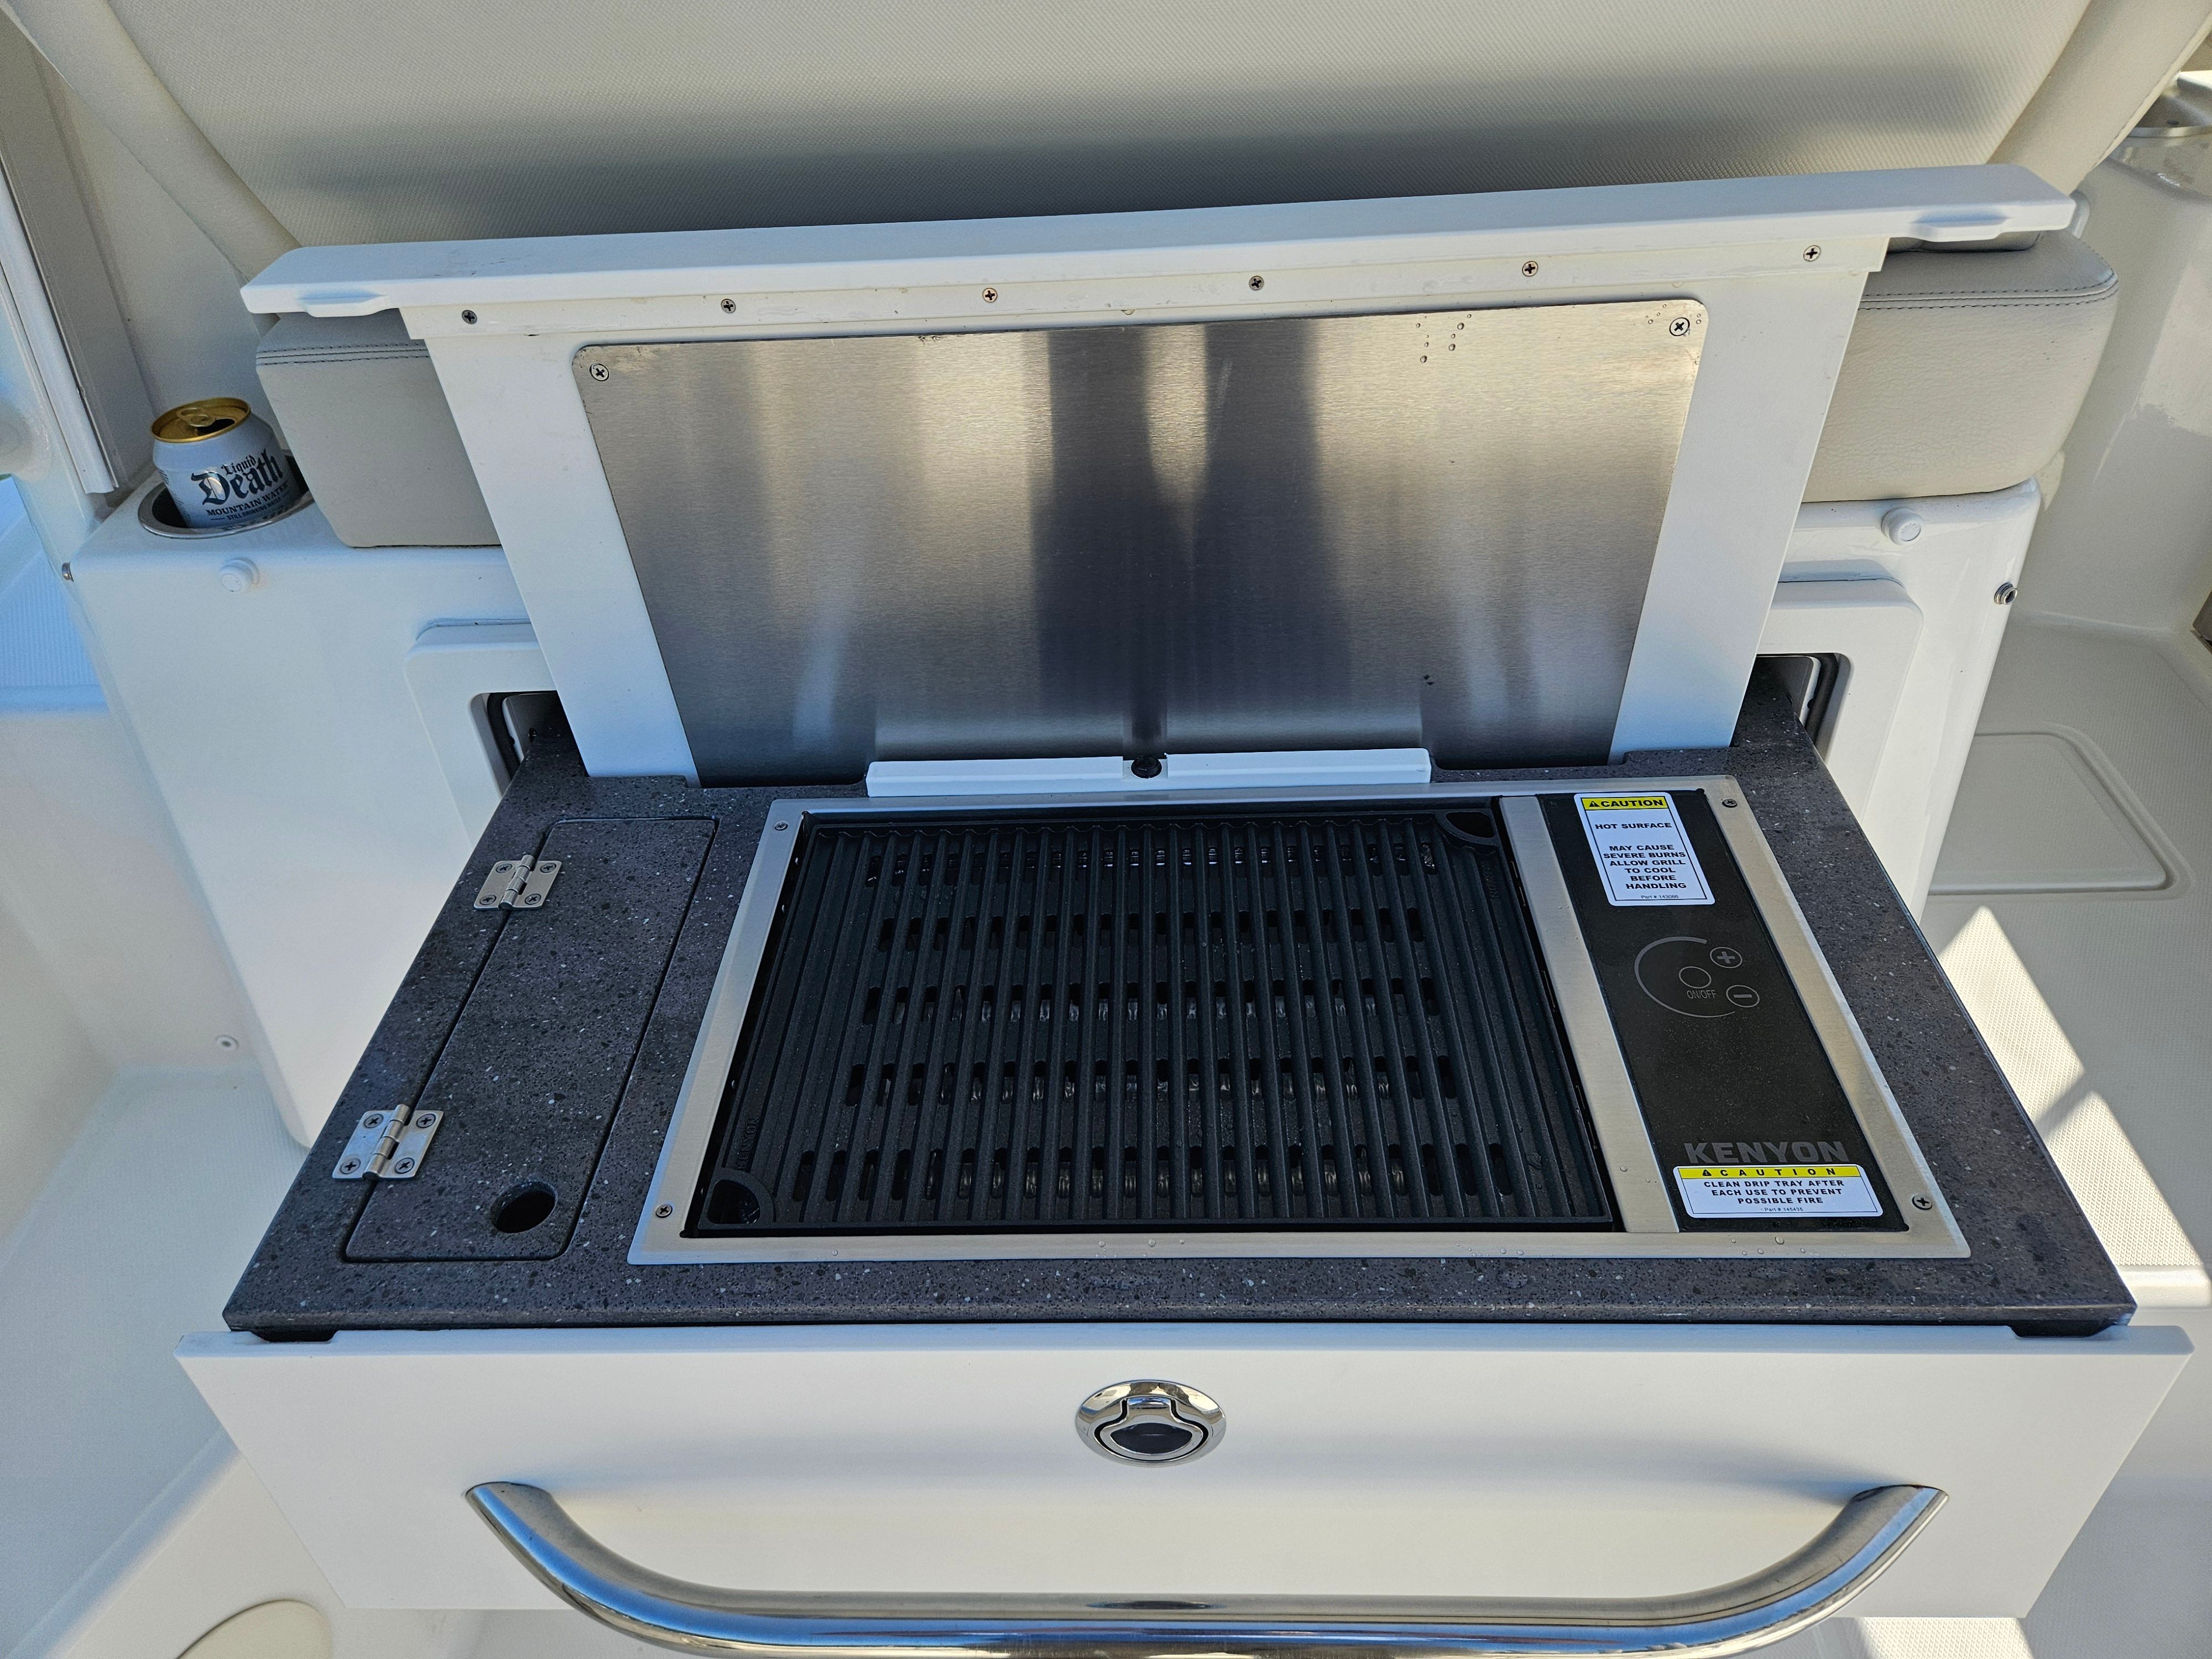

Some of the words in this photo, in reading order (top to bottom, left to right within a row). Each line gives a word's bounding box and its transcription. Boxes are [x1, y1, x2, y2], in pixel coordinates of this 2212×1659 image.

[191, 448, 283, 505] Death
[221, 455, 257, 476] Liquid
[206, 498, 261, 516] MOUNTAIN
[262, 480, 289, 502] WATER
[1687, 990, 1716, 999] ON/OFF
[1683, 1141, 1849, 1164] KENYON
[1720, 1168, 1835, 1177] CAUTION
